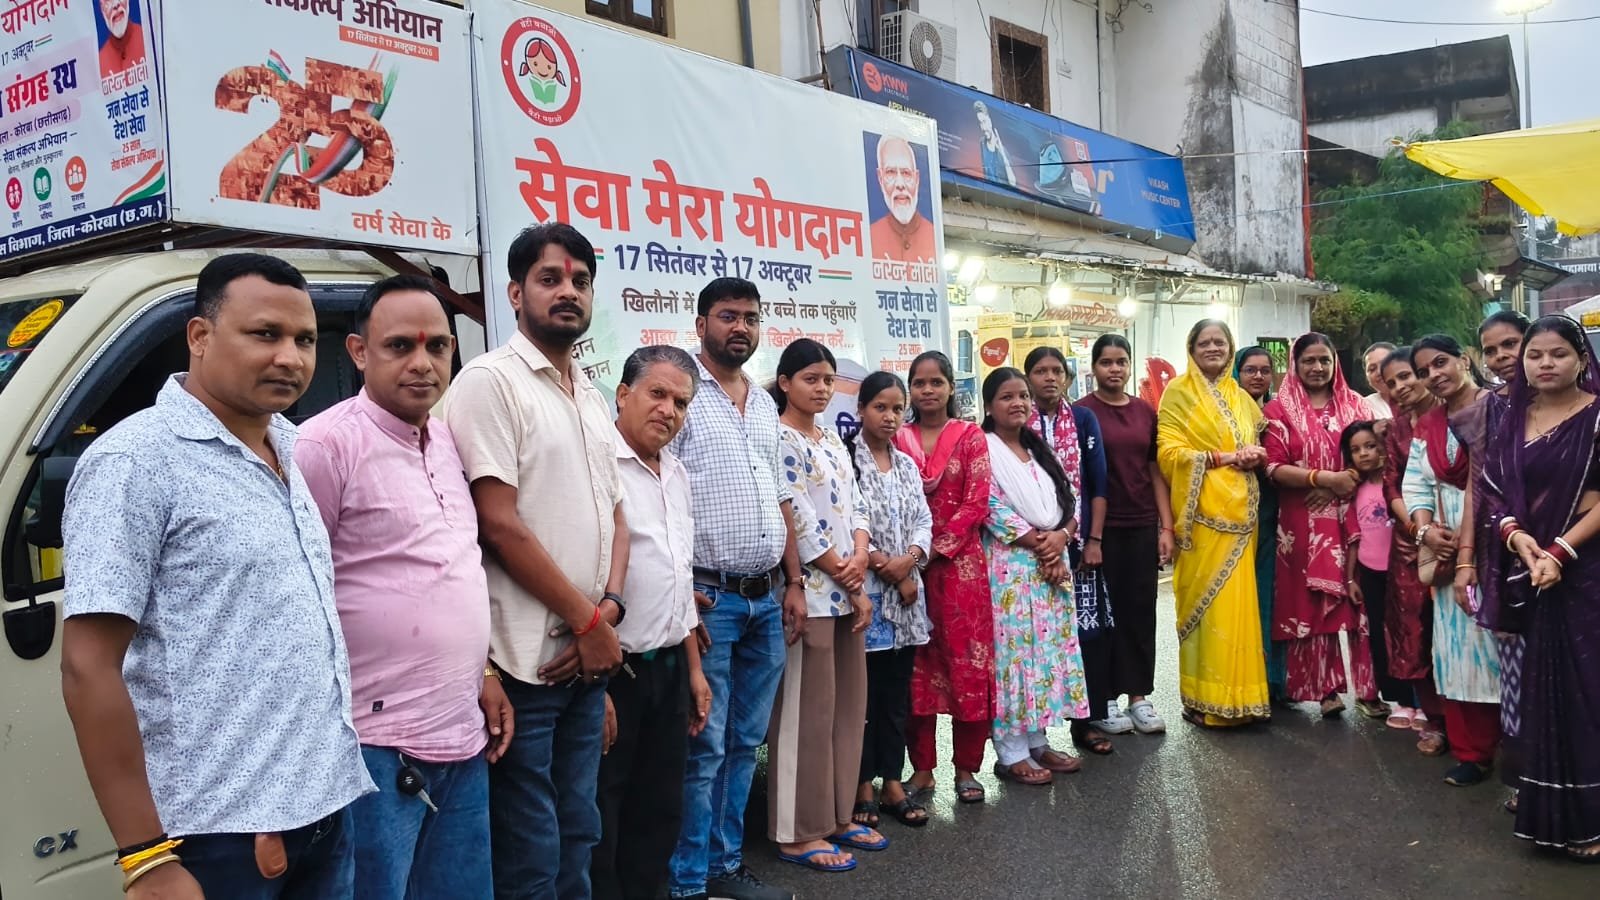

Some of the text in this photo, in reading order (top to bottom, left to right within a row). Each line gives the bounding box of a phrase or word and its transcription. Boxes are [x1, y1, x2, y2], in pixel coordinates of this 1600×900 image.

[347, 30, 355, 39] 17
[352, 0, 443, 42] अभियान
[2, 40, 34, 66] 17 अक्टूबर
[5, 70, 48, 113] संग्रह
[51, 58, 77, 94] रथ
[106, 85, 149, 120] जन सेवा से
[14, 121, 33, 137] कोरबा
[114, 114, 146, 140] देश सेवा
[214, 56, 395, 210] 25
[3, 131, 68, 163] सेवा संकल्प अभियान
[515, 137, 863, 260] सेवा मेरा योगदान
[1159, 195, 1181, 208] CENTER
[352, 208, 452, 240] वर्ष सेवा के
[8, 234, 45, 254] विभाग,
[614, 241, 812, 291] 17 सितंबर से 17 अक्टूबर
[622, 287, 679, 314] खिलौनों
[682, 291, 695, 314] में
[773, 298, 796, 319] बच्चे
[799, 303, 818, 319] तक
[821, 299, 856, 325] पहुँचाएँ
[876, 290, 898, 311] जन
[925, 288, 938, 312] से
[886, 312, 931, 338] देश सेवा
[899, 343, 907, 355] 25
[582, 359, 611, 381] कान
[33, 829, 78, 858] CX
